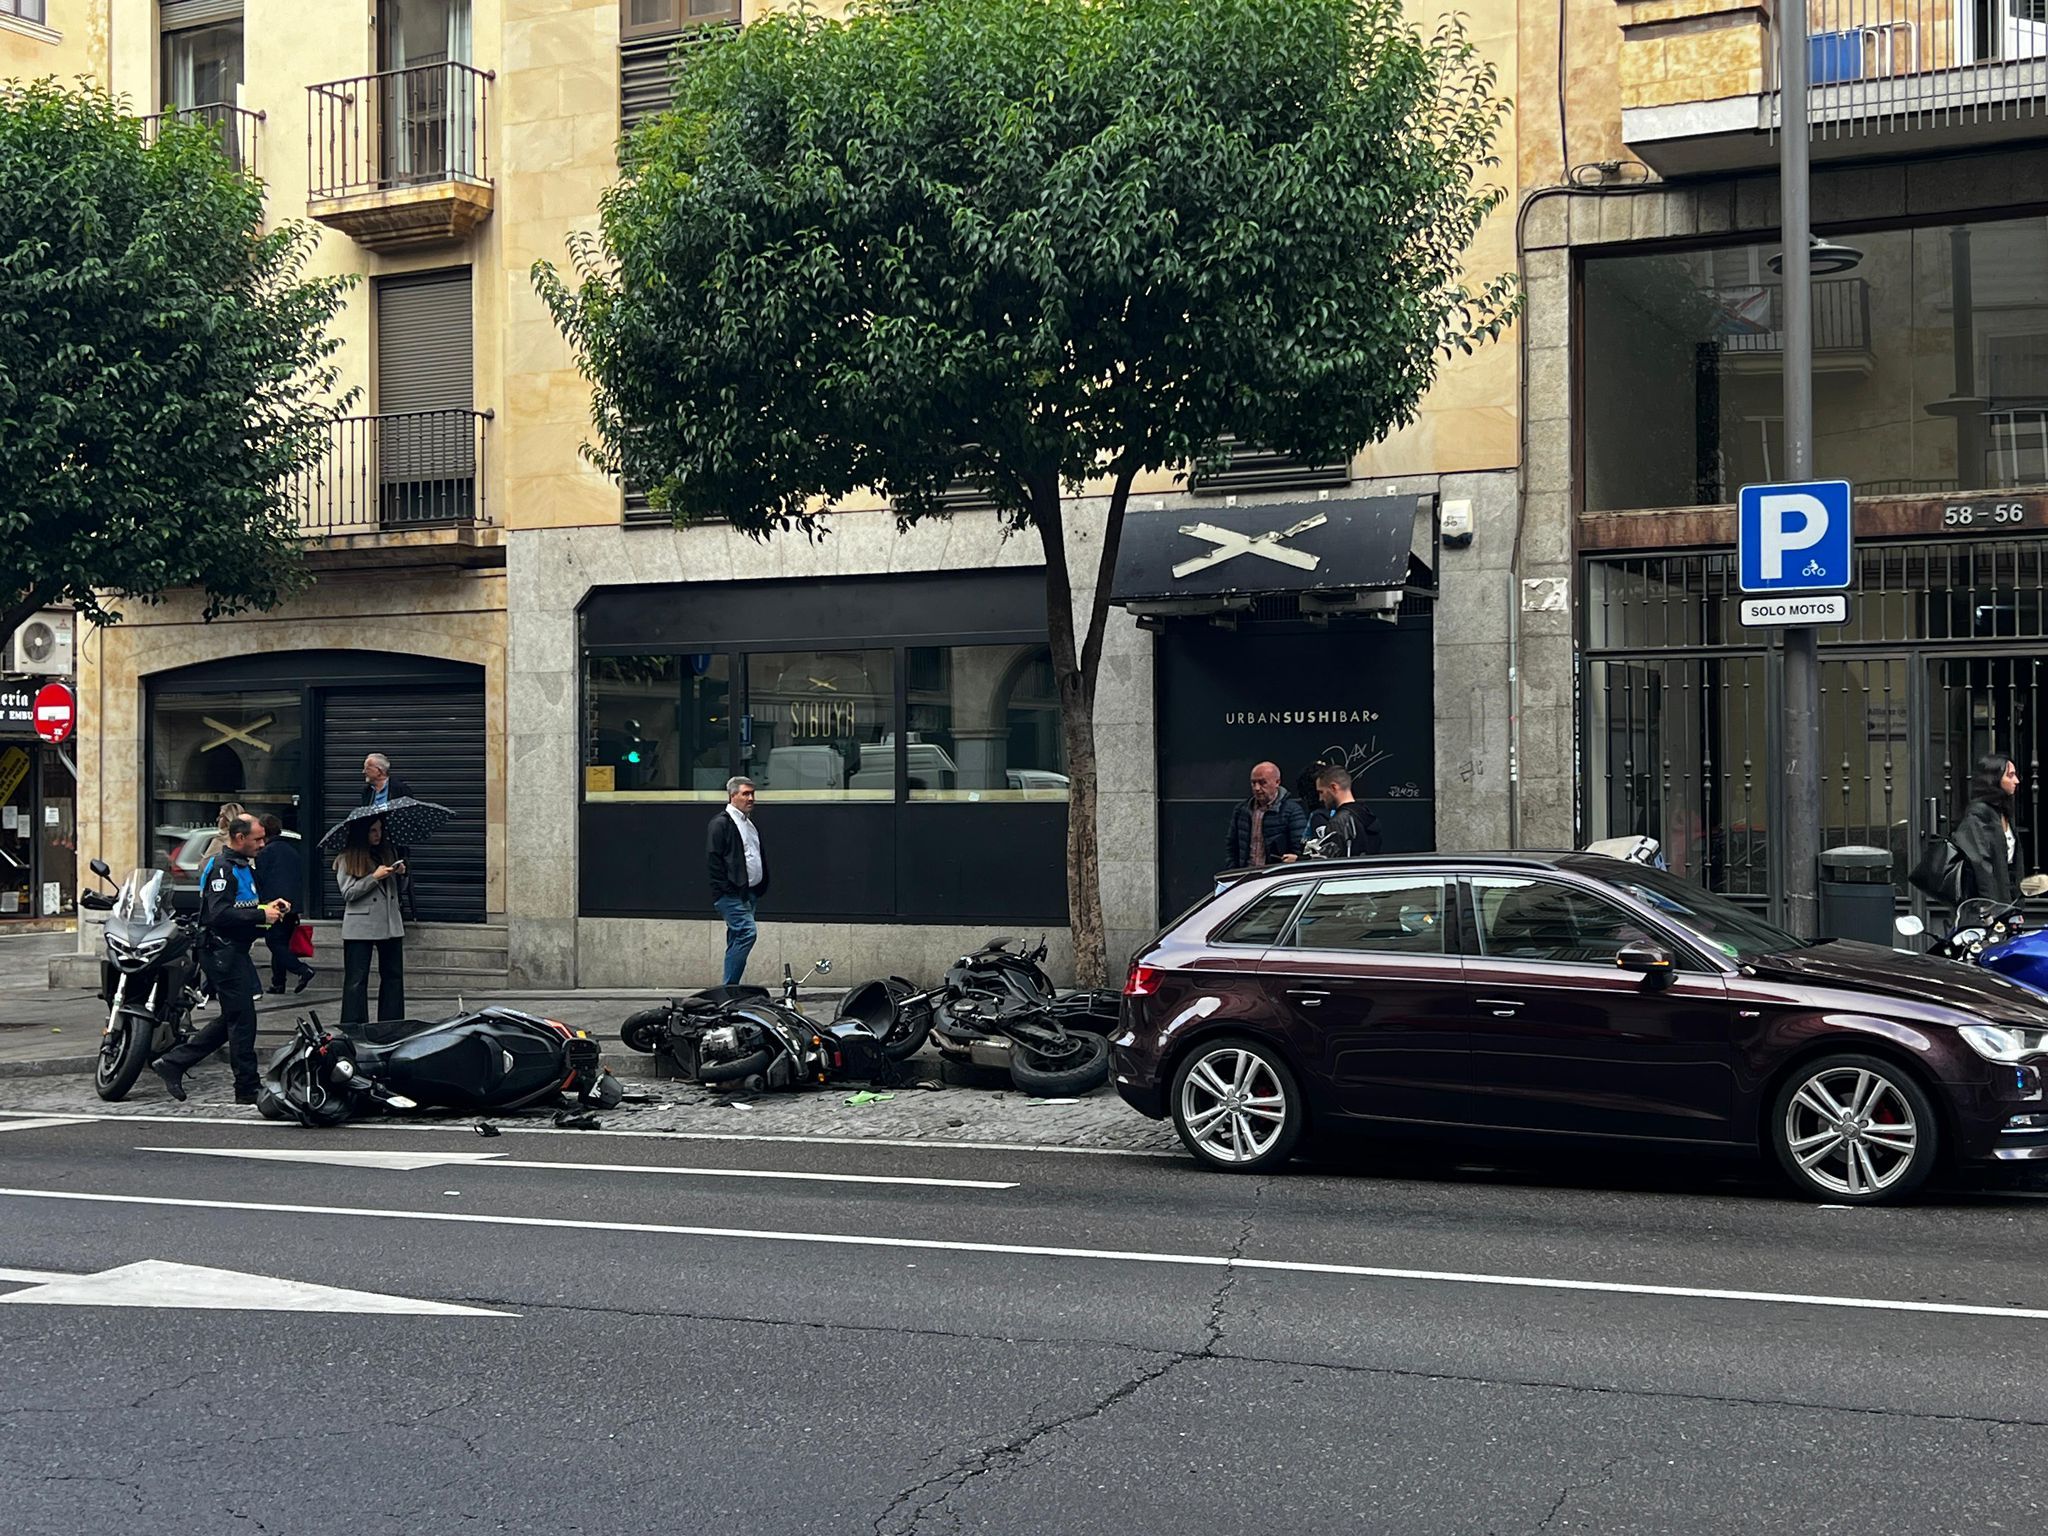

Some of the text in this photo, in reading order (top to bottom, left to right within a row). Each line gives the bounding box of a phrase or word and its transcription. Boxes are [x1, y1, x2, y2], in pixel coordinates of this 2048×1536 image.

[1944, 506, 1973, 525] 58
[1994, 503, 2023, 523] 56
[1760, 493, 1829, 580] P
[1751, 603, 1835, 617] SOLO MOTOS
[790, 701, 855, 738] SIBUYA
